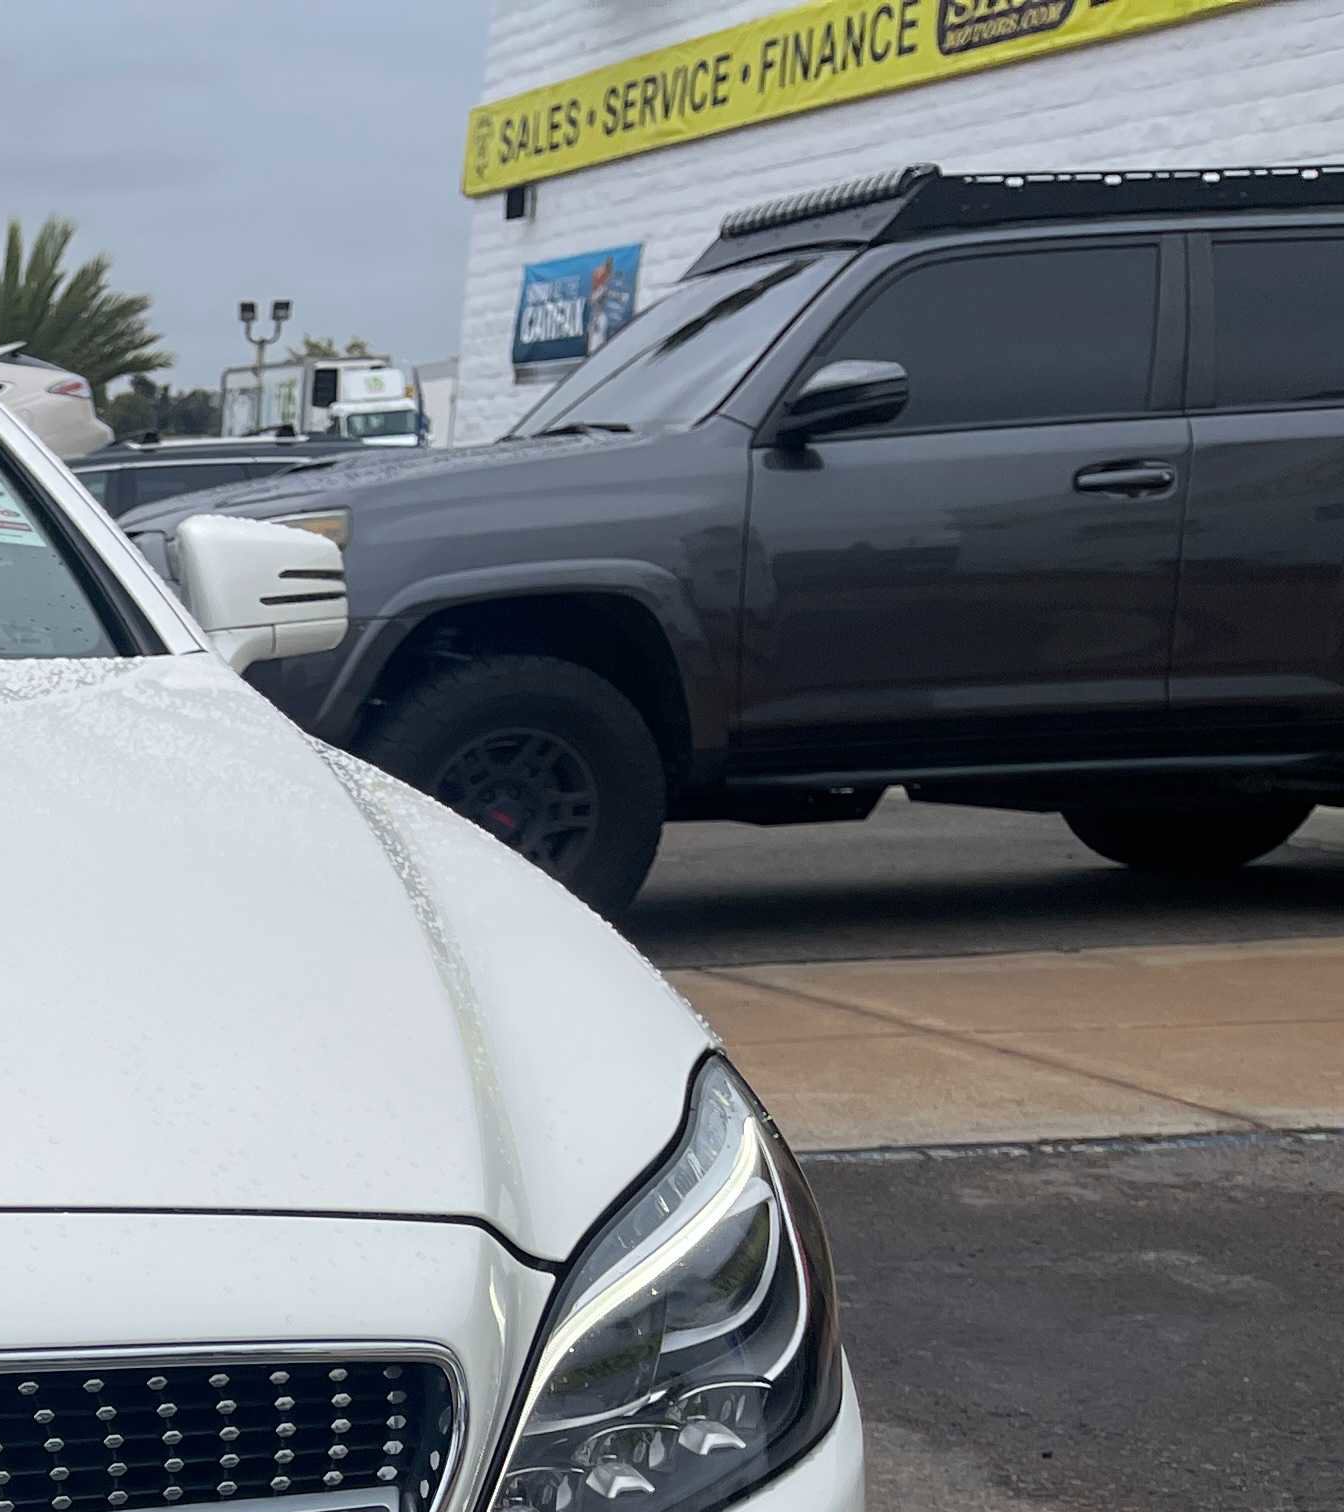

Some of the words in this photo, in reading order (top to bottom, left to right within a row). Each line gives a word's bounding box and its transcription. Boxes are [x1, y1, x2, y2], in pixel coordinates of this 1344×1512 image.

[499, 99, 580, 166] SALES
[602, 54, 730, 138] SERVICE
[758, 1, 920, 94] FINANCE
